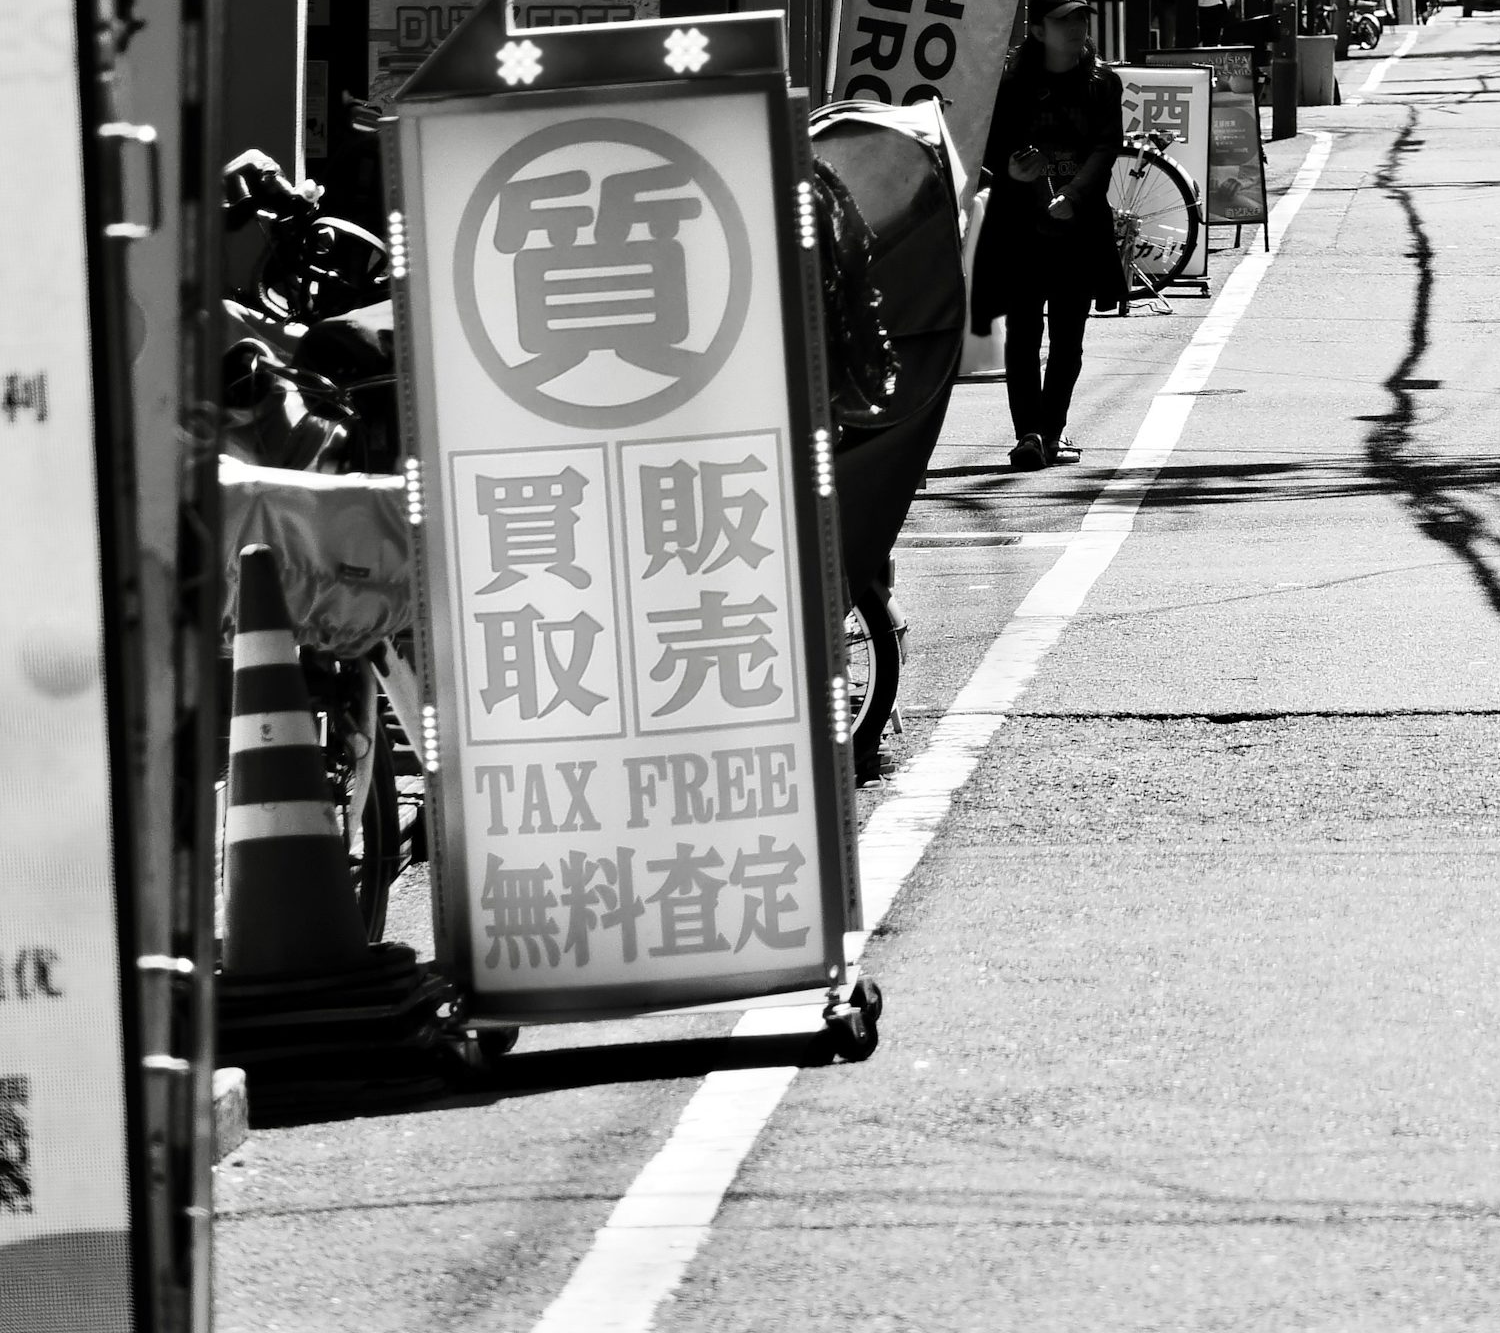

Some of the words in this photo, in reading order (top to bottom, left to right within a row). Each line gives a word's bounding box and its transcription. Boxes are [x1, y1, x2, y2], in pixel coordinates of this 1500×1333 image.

[1122, 83, 1193, 144] 酒
[500, 171, 706, 393] 質
[471, 463, 611, 724] 買取
[638, 452, 785, 719] 販売
[475, 759, 603, 838] TAX
[626, 744, 800, 828] FREE
[477, 835, 812, 971] 無料査定
